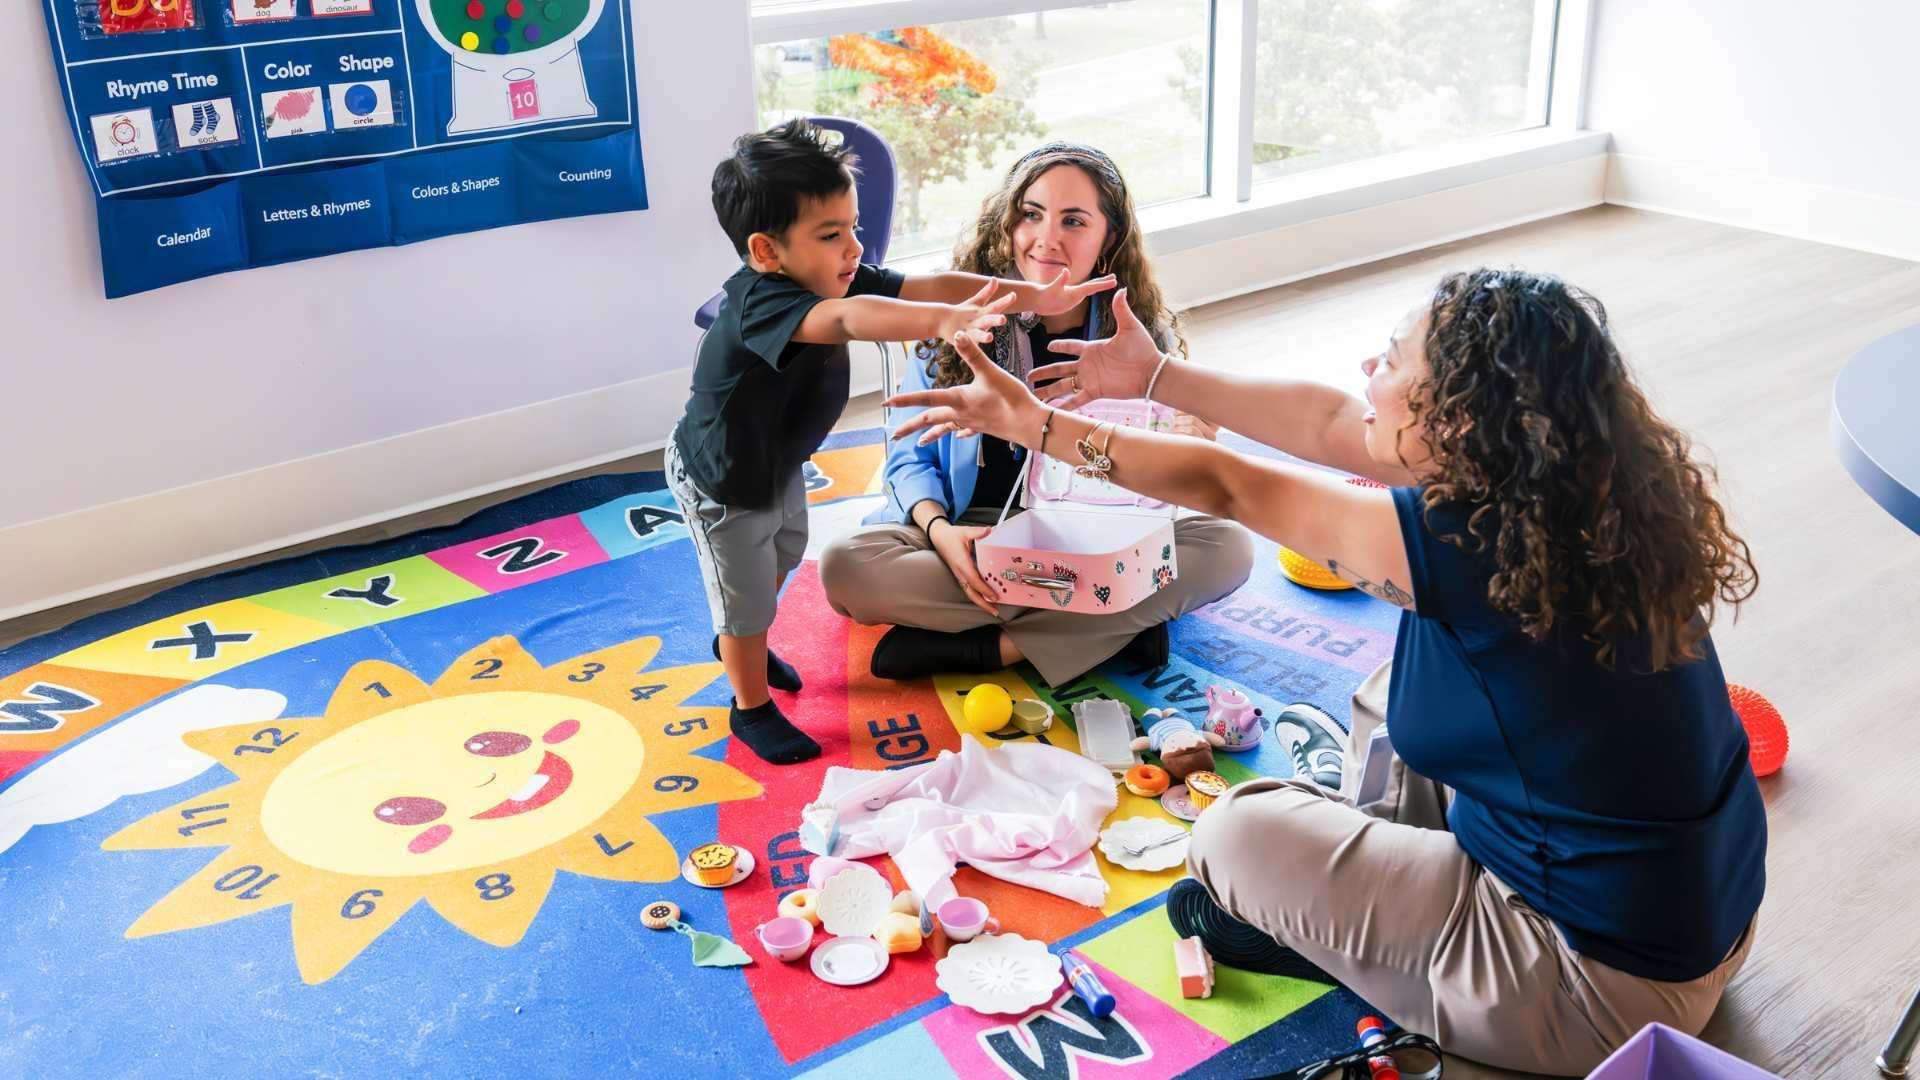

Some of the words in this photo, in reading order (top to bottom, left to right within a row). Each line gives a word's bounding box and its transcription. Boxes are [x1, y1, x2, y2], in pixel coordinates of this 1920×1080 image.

[255, 9, 271, 17] dog
[325, 5, 358, 13] dinosaur
[264, 61, 313, 80] Color
[339, 54, 394, 74] Shape
[107, 80, 169, 100] Rhyme
[172, 72, 218, 90] Time
[514, 91, 536, 109] 10
[353, 117, 374, 126] circle
[198, 135, 219, 144] sock
[117, 146, 140, 157] clock
[558, 167, 612, 183] Counting
[411, 183, 449, 200] Colors
[451, 181, 461, 194] &
[462, 175, 500, 191] Shapes
[262, 204, 308, 223] Letters
[311, 204, 321, 217] &
[324, 198, 372, 218] Rhymes
[157, 225, 212, 248] Calendar
[152, 620, 254, 661] X
[325, 574, 402, 607] Y
[479, 537, 567, 574] Z
[628, 506, 686, 537] A
[469, 658, 503, 681] 2
[567, 662, 606, 682] 3
[363, 681, 393, 699] 1
[629, 683, 669, 702] 4
[663, 716, 709, 737] 5
[233, 727, 300, 756] 12
[653, 774, 700, 793] 6
[178, 803, 230, 837] 11
[593, 832, 635, 857] 7
[768, 831, 811, 905] ED
[213, 864, 280, 900] 10
[474, 872, 516, 901] 8
[340, 888, 384, 920] 9
